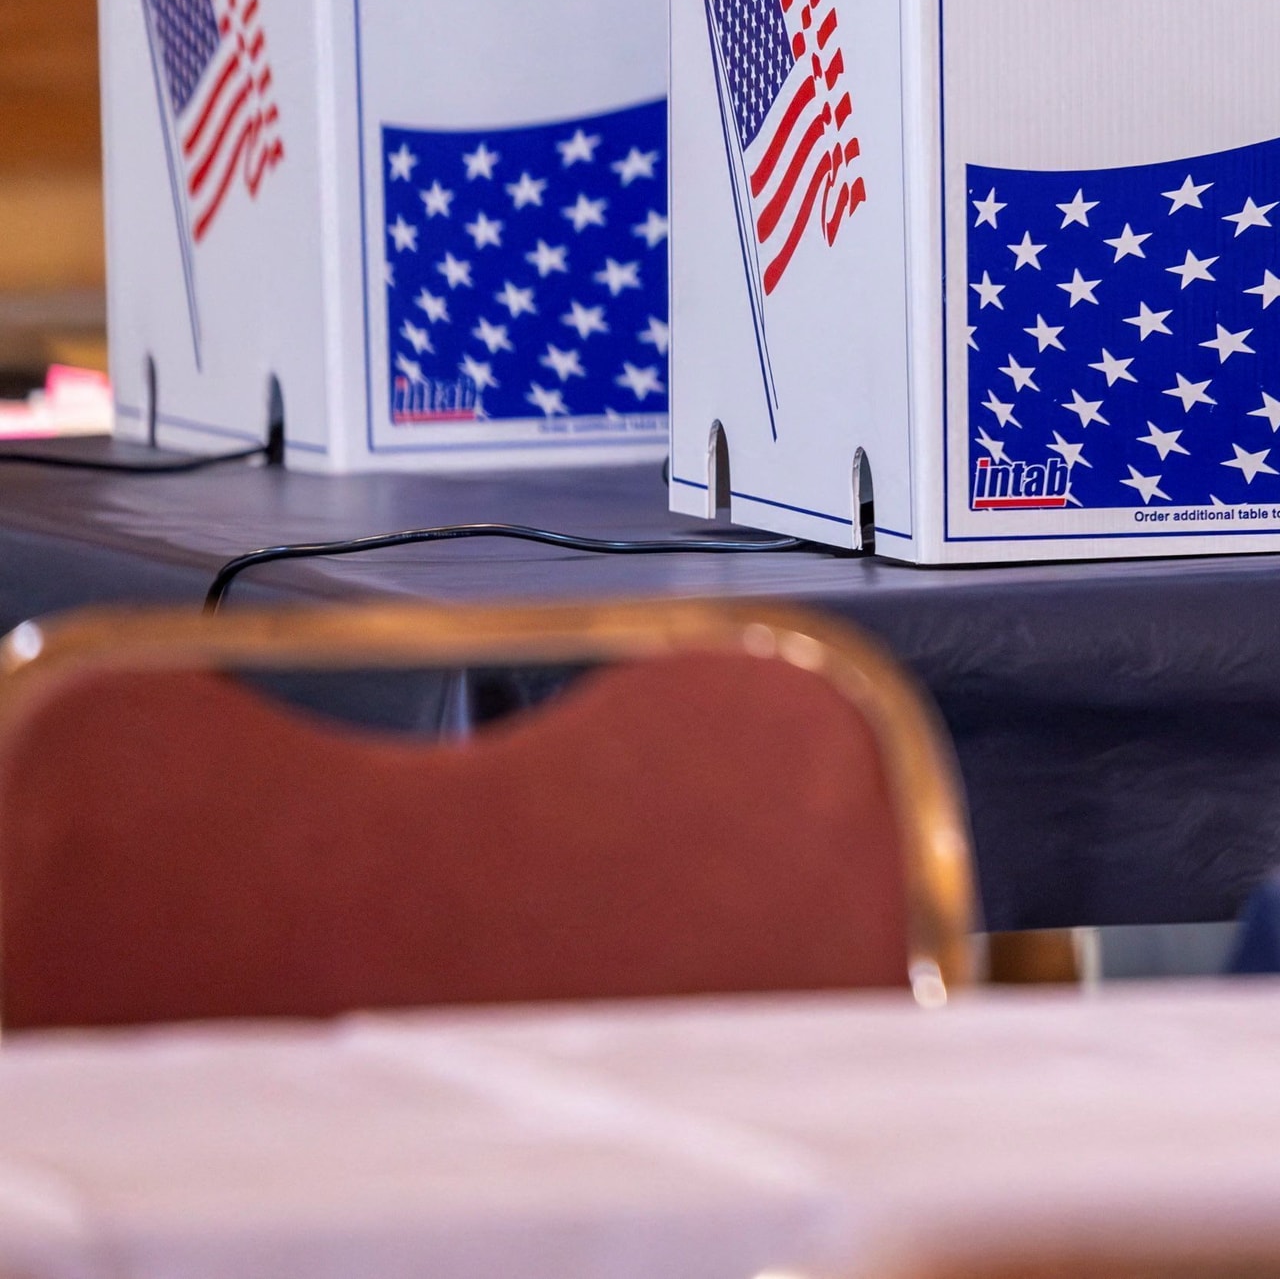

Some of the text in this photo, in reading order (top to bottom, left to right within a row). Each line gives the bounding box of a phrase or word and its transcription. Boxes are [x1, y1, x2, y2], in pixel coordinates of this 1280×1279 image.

[975, 457, 1068, 498] intab
[1134, 510, 1171, 523] Order
[1172, 509, 1235, 522] additional
[1238, 508, 1269, 520] table
